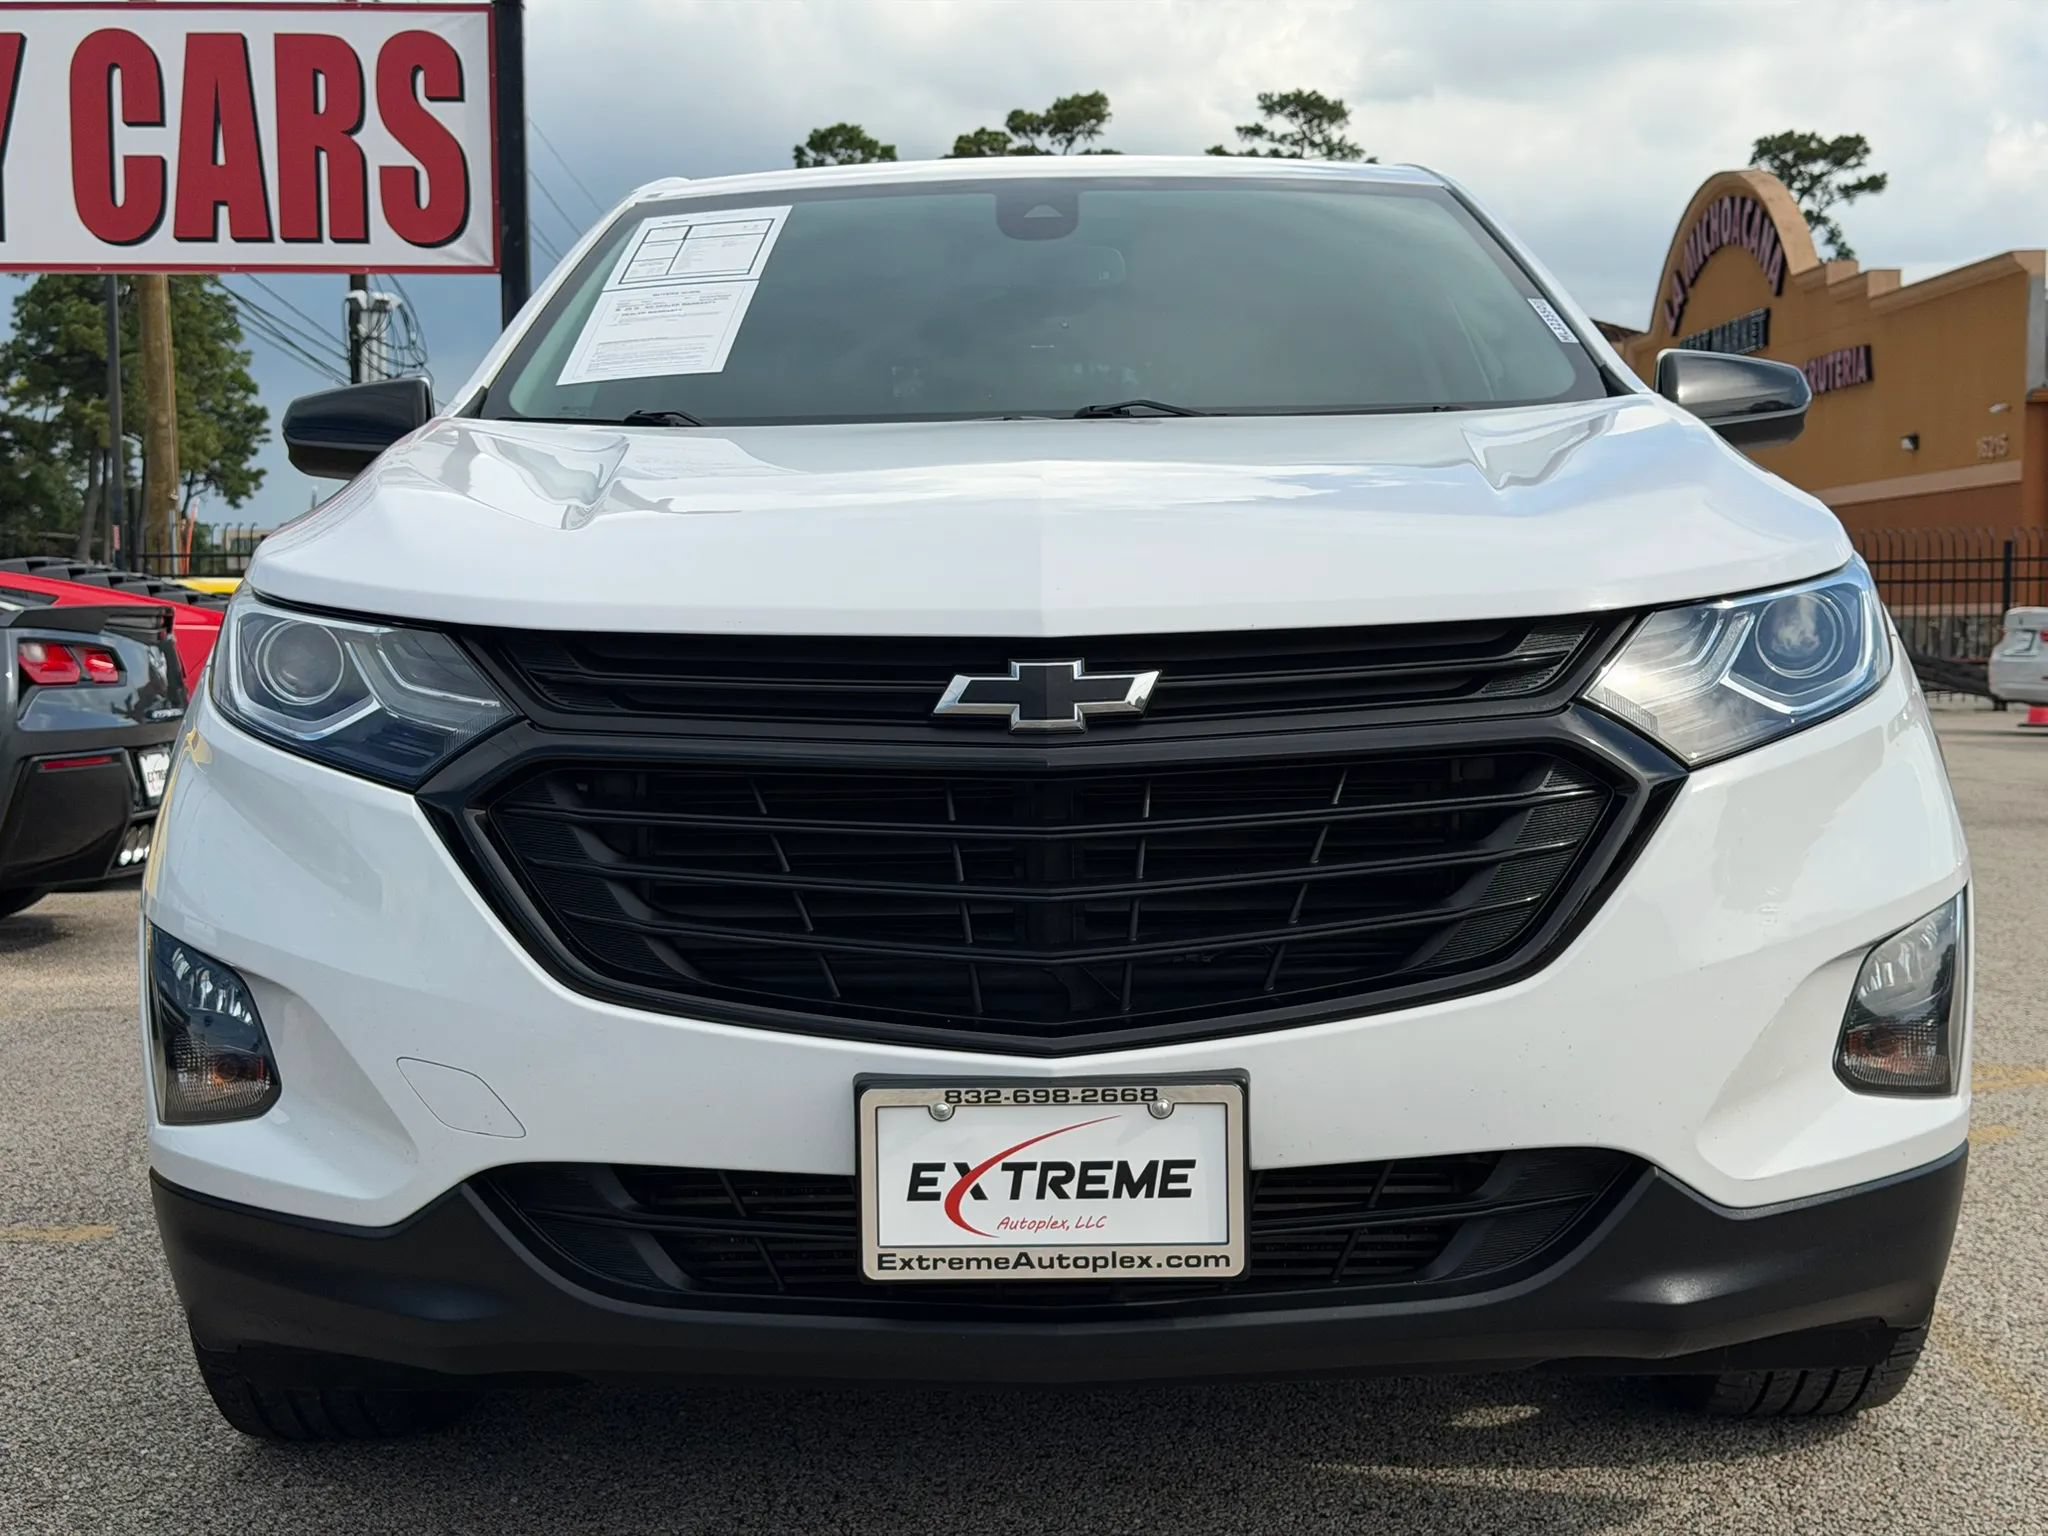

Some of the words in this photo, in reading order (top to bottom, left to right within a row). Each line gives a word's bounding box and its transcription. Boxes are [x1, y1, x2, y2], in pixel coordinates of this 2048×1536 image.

[69, 28, 470, 249] CARS
[1664, 270, 1688, 336] LA
[1684, 195, 1787, 296] MICHOACANA
[944, 1087, 1159, 1105] 832-698-2668
[906, 1158, 1197, 1202] EXTREME
[996, 1215, 1071, 1234] Autoplex,
[1074, 1215, 1108, 1230] LLC
[877, 1251, 1231, 1273] ExtremeAutoplex.com
